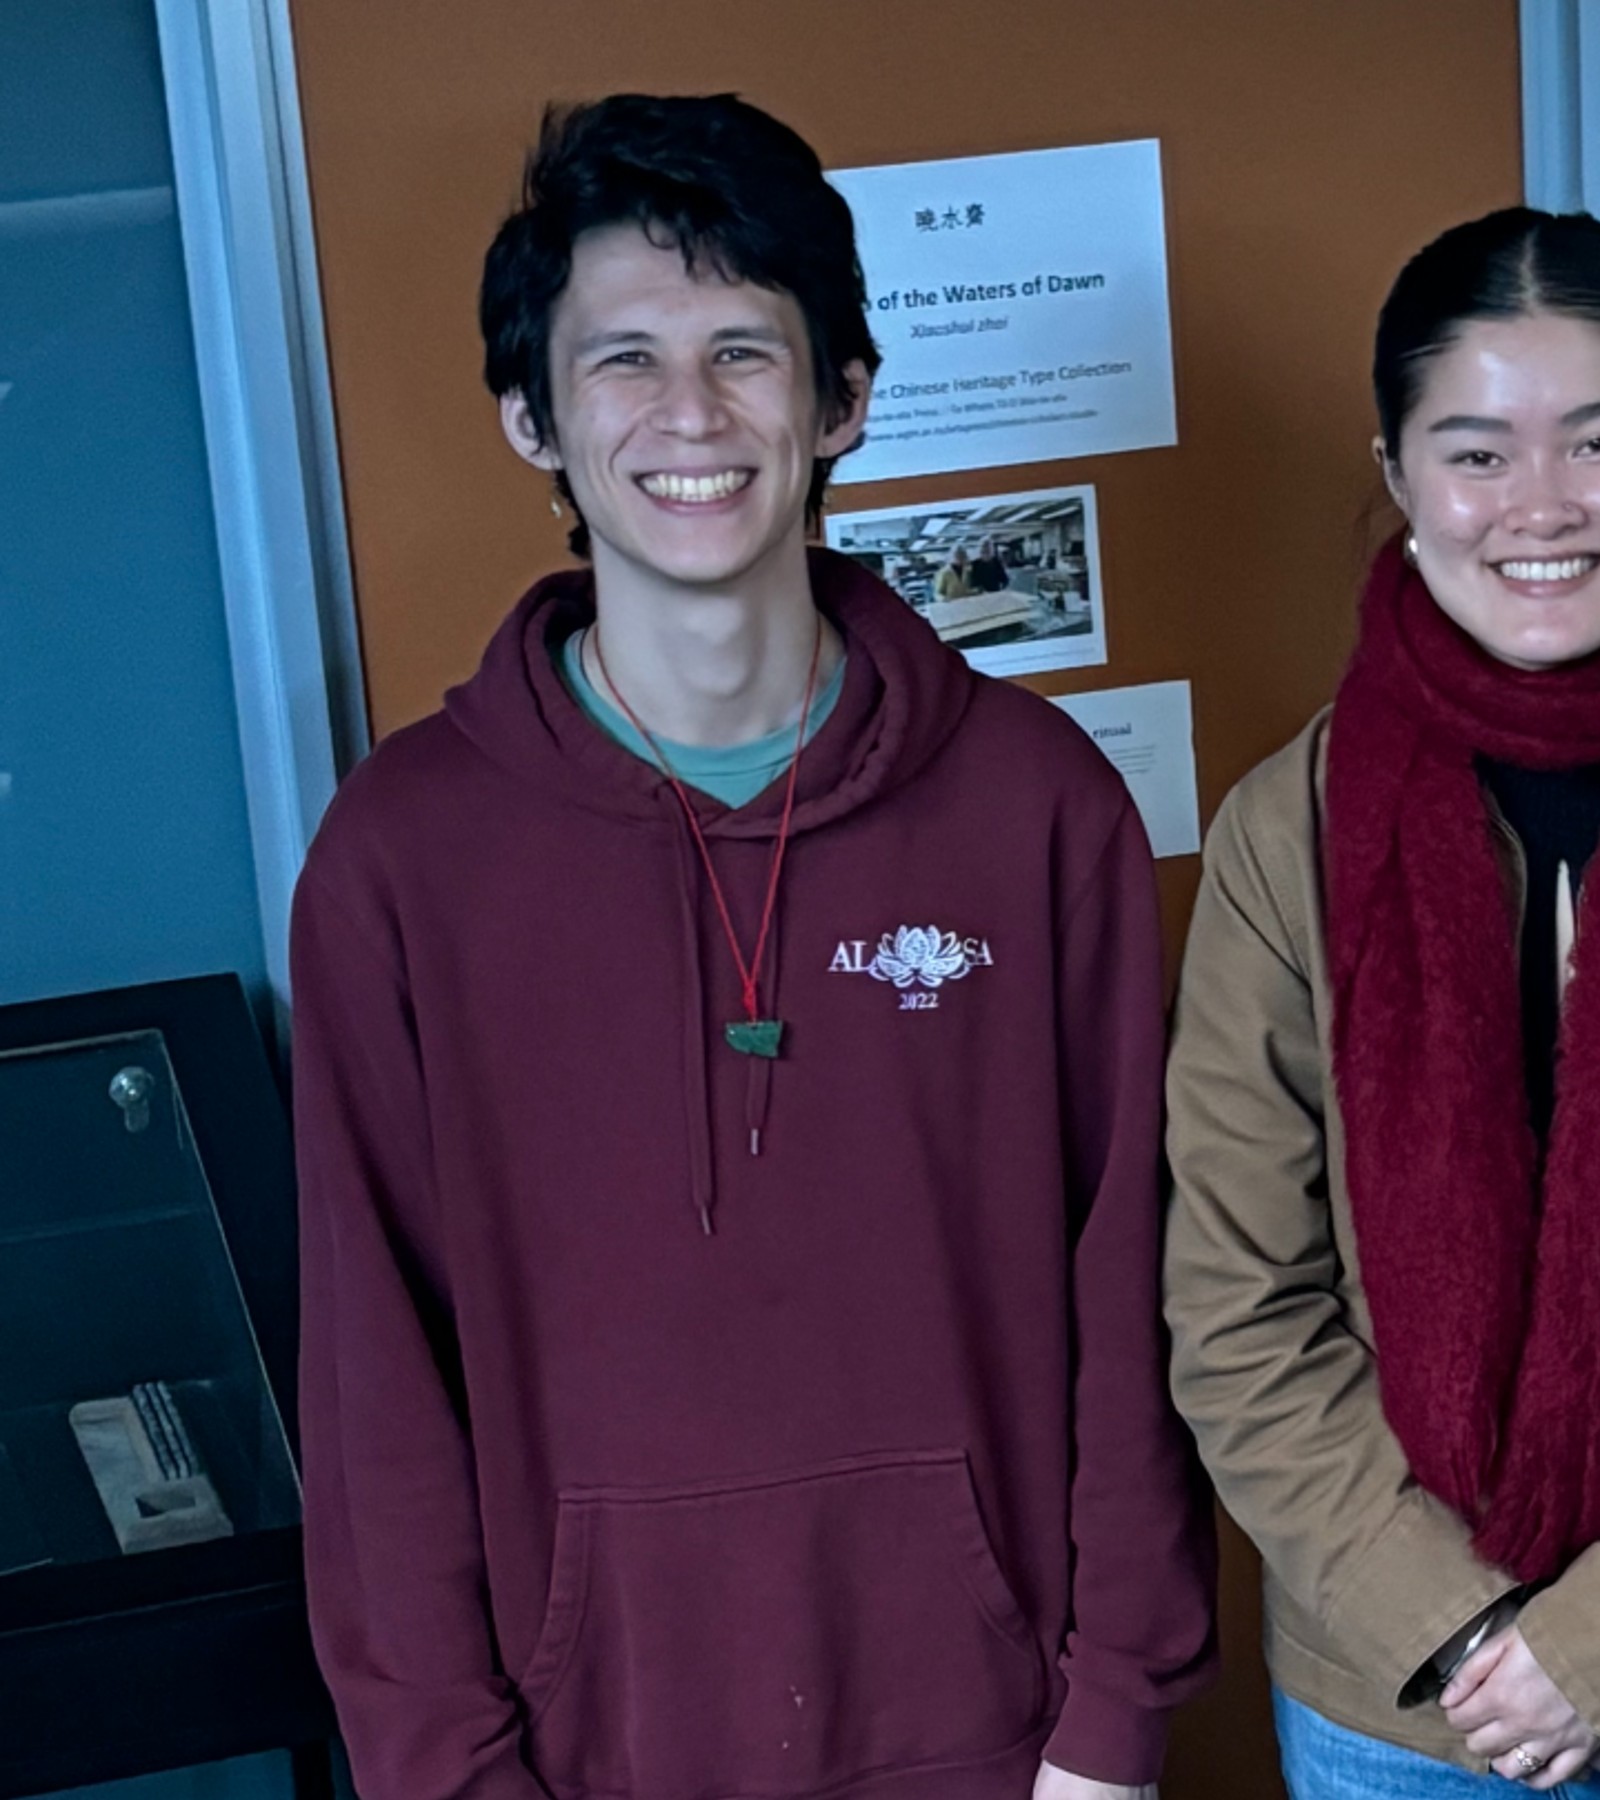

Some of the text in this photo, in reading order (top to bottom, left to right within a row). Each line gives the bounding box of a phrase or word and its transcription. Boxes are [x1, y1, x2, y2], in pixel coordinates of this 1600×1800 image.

[877, 291, 899, 310] of
[904, 288, 938, 308] the
[942, 282, 1016, 304] Waters
[1022, 275, 1043, 295] of
[1048, 272, 1105, 293] Dawn
[890, 382, 949, 399] Chinese
[953, 374, 1017, 392] Heritage
[1021, 370, 1055, 388] Type
[1059, 360, 1131, 380] Collection
[899, 992, 939, 1010] 2022
